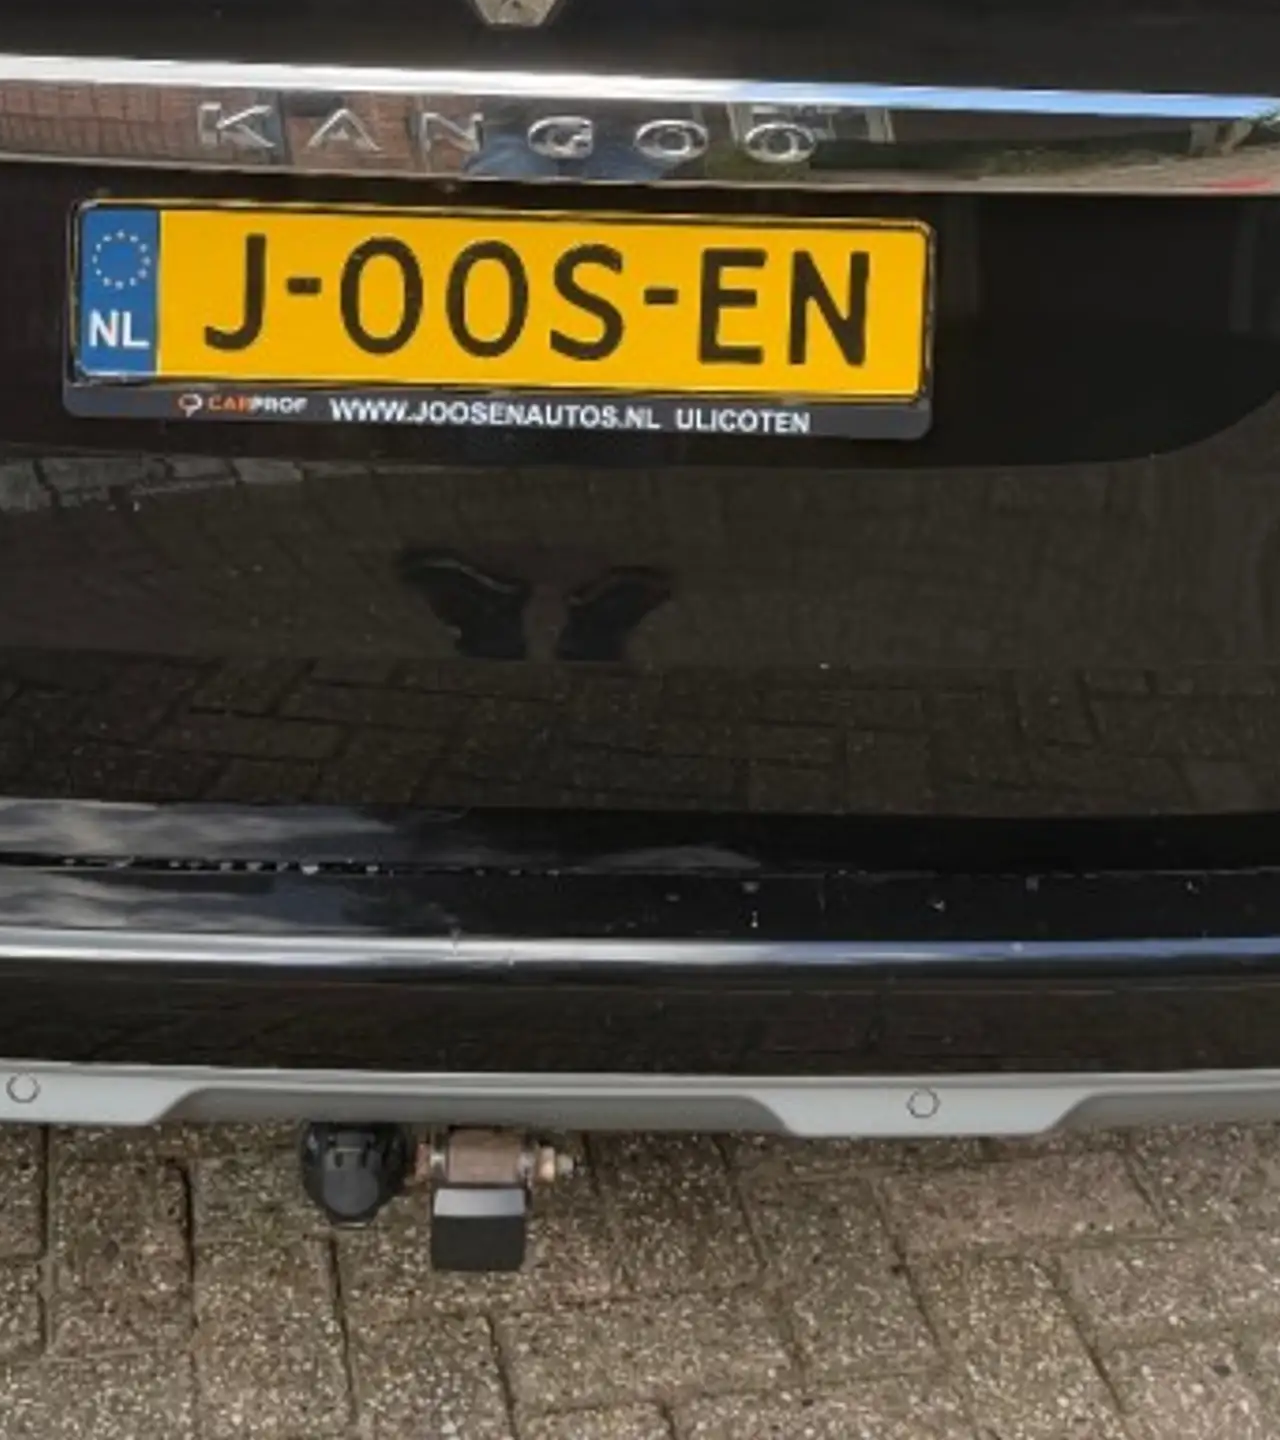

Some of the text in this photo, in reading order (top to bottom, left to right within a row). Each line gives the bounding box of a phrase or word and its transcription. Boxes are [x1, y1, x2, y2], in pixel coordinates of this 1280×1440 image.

[196, 101, 818, 163] KANGOO
[89, 309, 150, 351] NL
[208, 395, 811, 434] CARPROF WWW.JOOSENAUTOS.NL ULICOTEN
